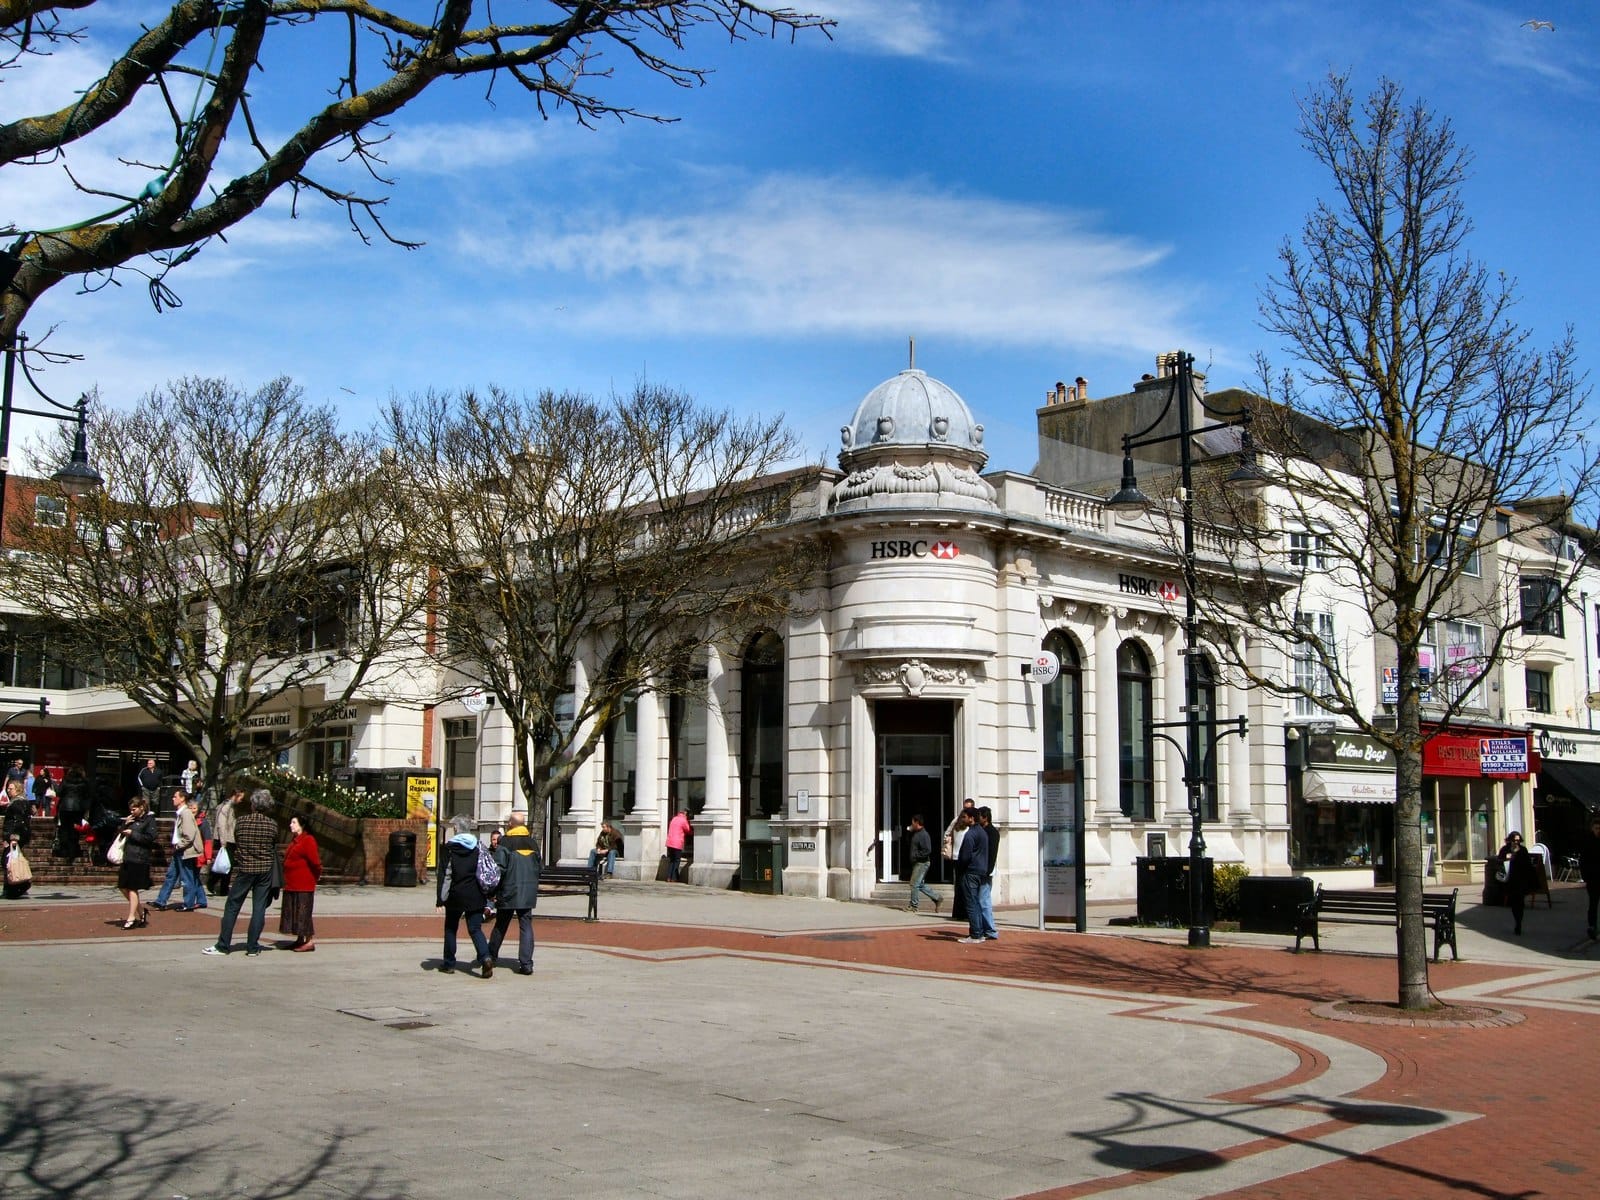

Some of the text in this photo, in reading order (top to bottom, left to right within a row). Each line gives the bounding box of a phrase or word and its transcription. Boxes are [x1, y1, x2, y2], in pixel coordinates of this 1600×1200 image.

[871, 540, 928, 559] HSBC
[1119, 573, 1158, 598] HSBC
[1032, 666, 1054, 676] HSBC
[1335, 741, 1387, 762] dstone Bags
